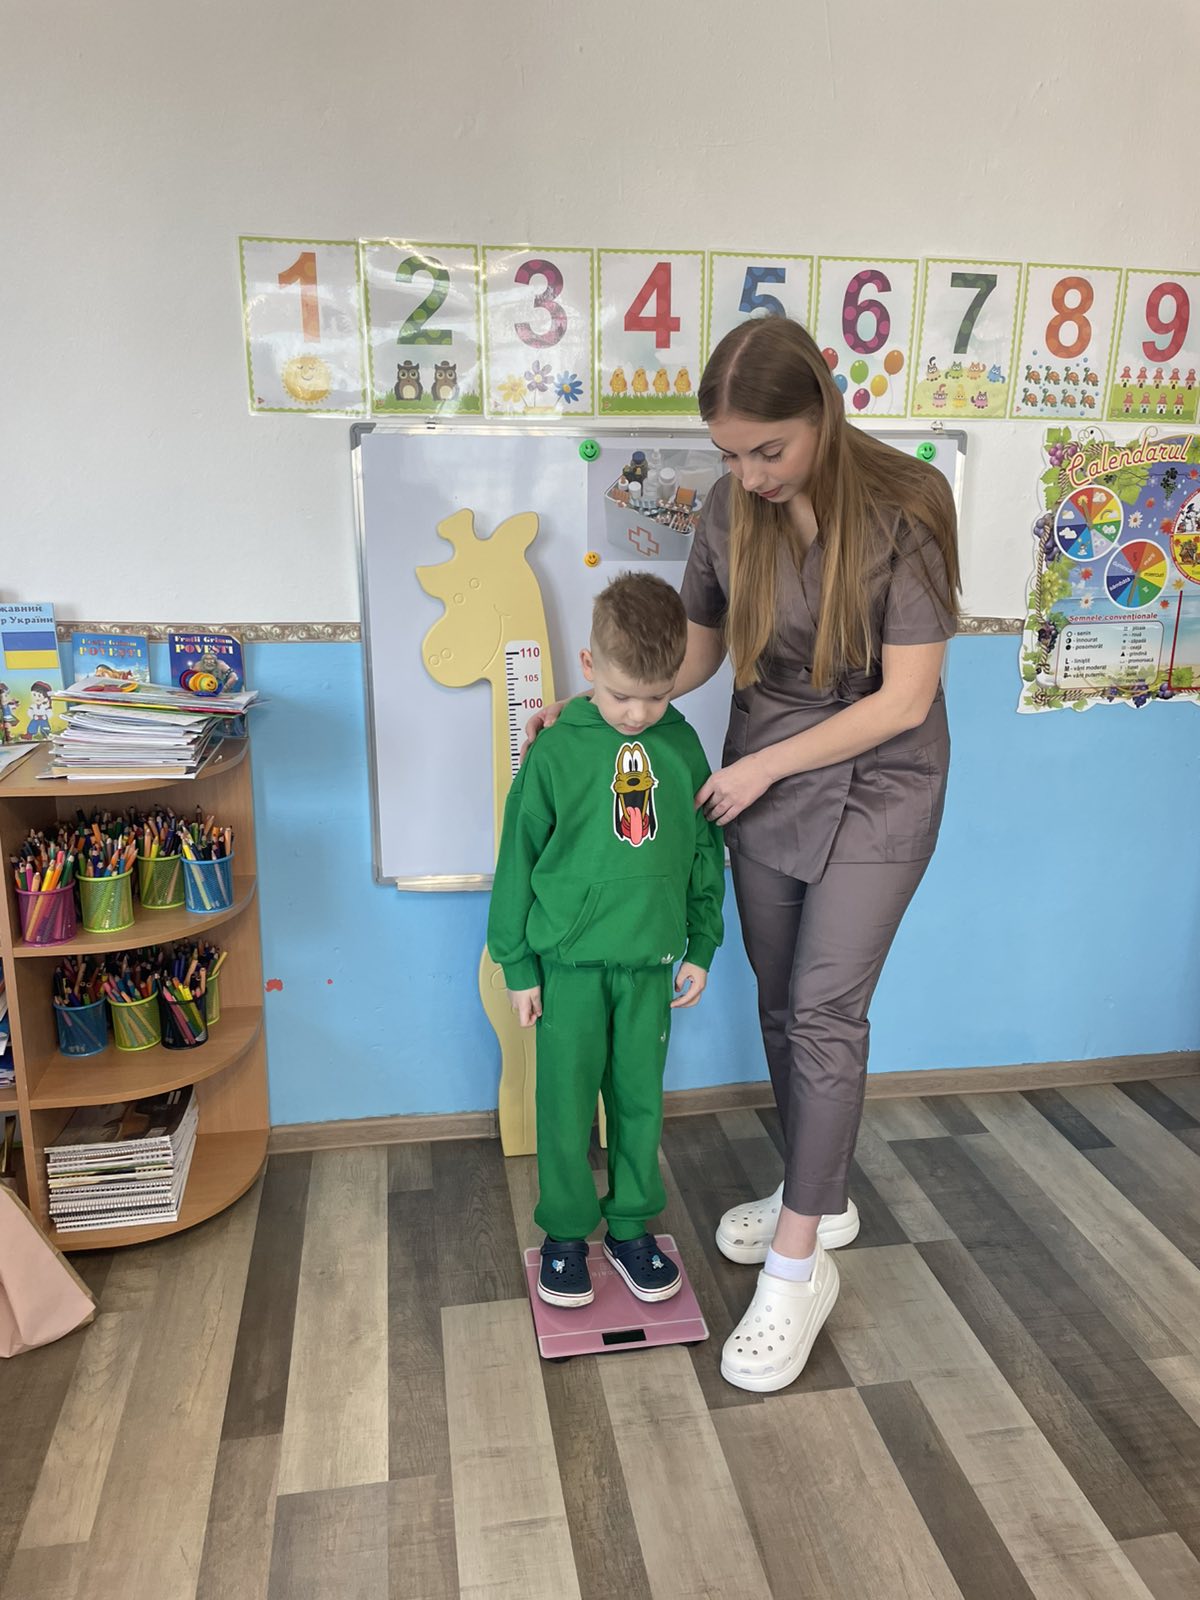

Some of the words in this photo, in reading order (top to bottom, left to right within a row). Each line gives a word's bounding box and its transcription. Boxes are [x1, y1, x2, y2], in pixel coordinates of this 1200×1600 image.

[278, 252, 321, 343] 1
[395, 256, 452, 345] 2
[514, 259, 567, 349] 3
[624, 262, 681, 349] 4
[842, 269, 892, 355] 6
[950, 272, 998, 354] 7
[1045, 276, 1094, 359] 8
[1142, 282, 1190, 363] 9
[1066, 434, 1194, 488] Calendarul
[520, 647, 540, 658] 110
[524, 674, 539, 683] 105
[522, 698, 543, 709] 100
